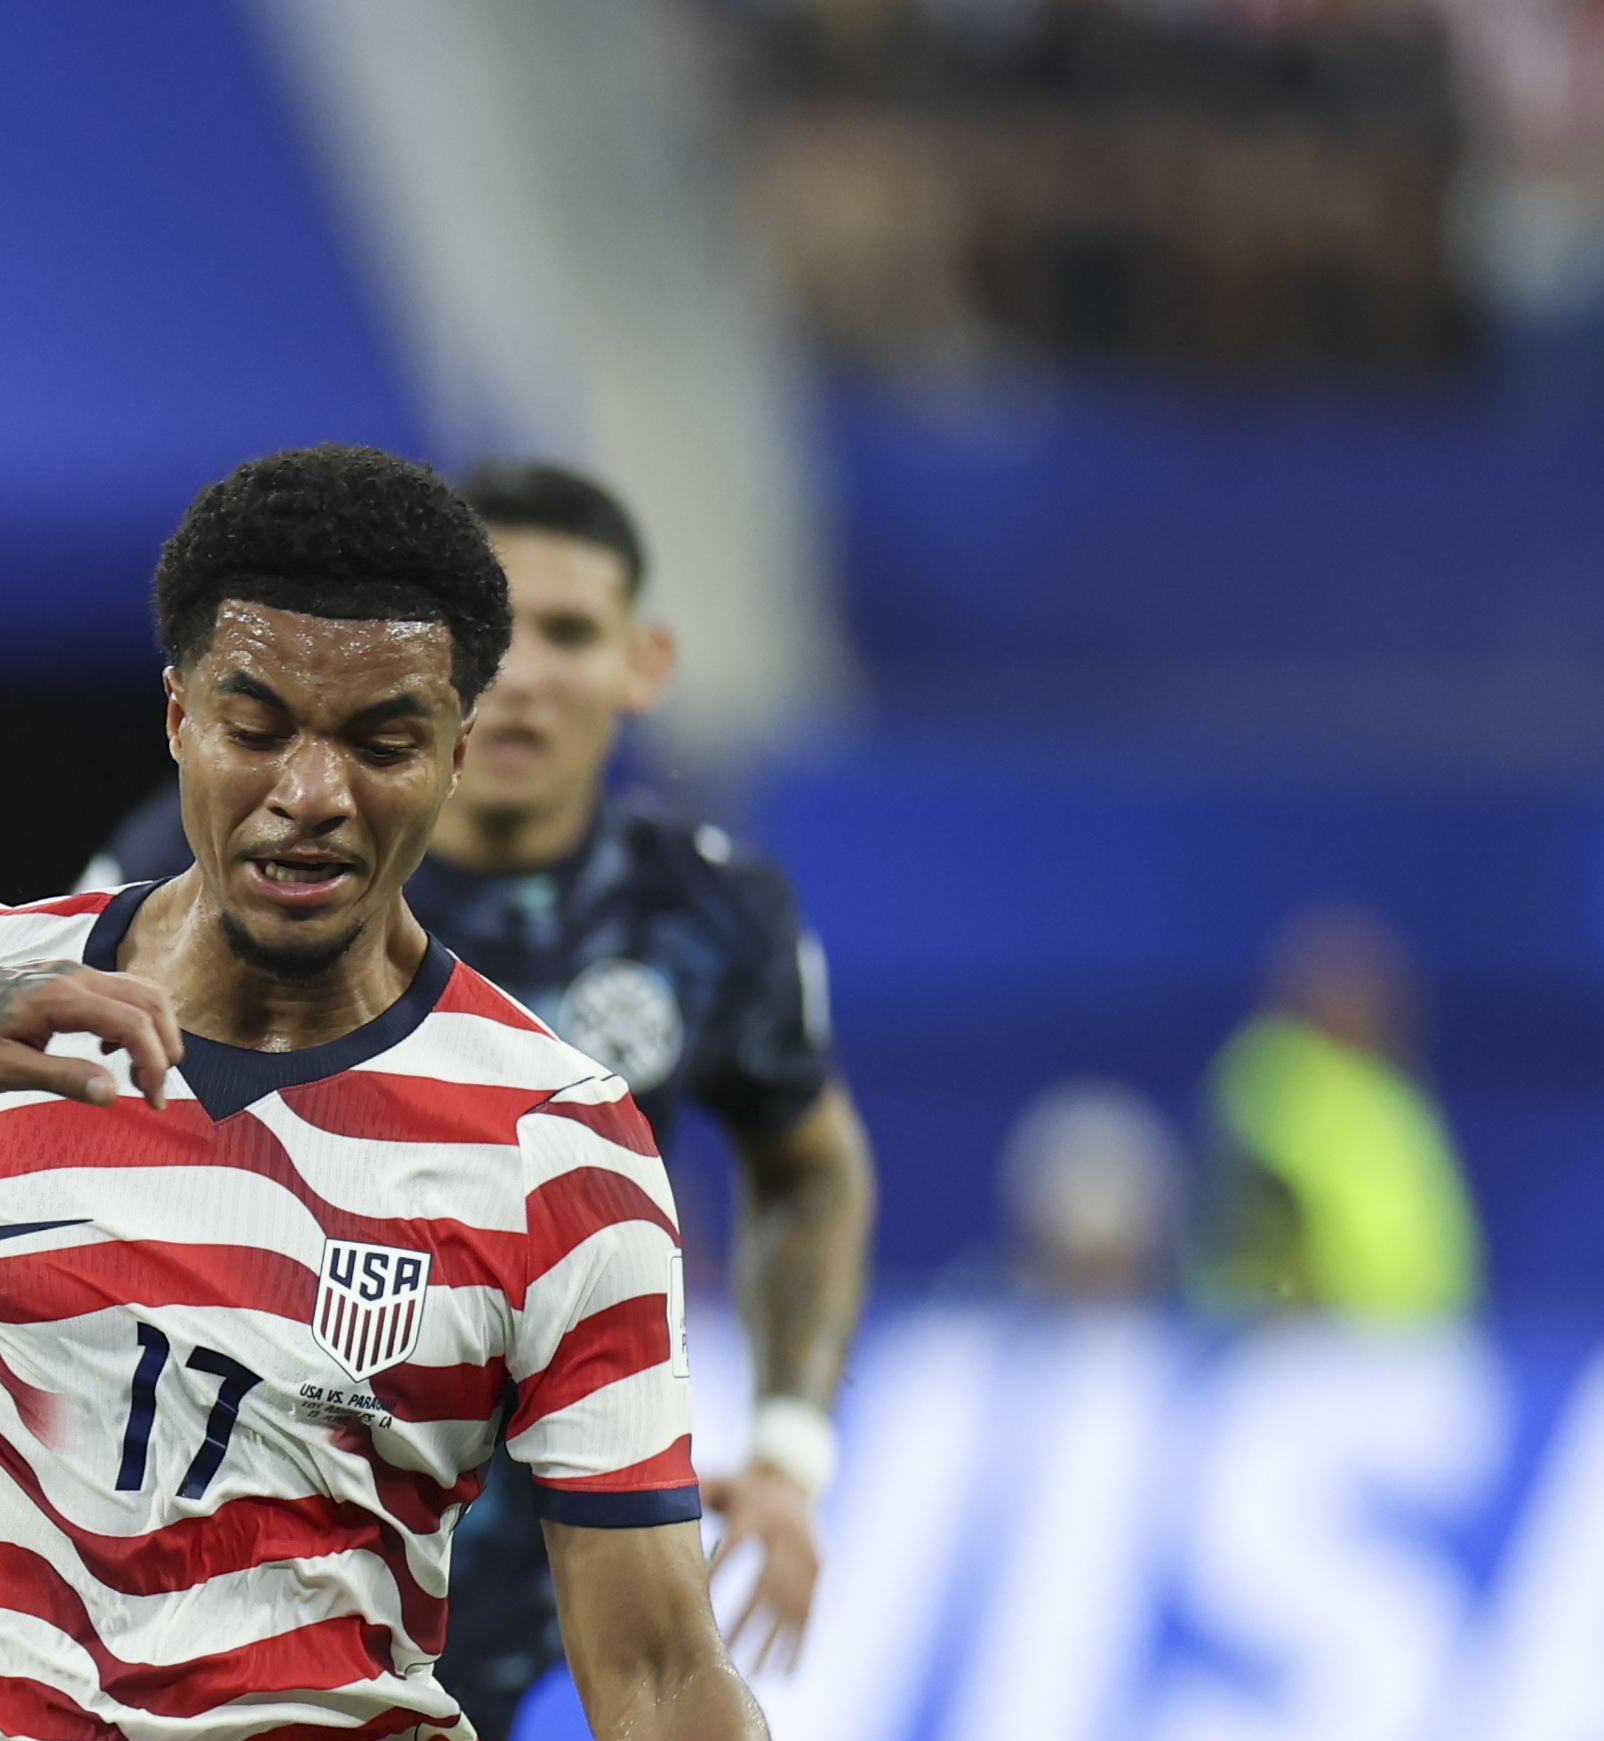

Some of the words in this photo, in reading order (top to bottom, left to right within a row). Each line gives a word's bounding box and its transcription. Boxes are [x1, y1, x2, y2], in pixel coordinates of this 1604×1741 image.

[328, 1247, 422, 1302] USA
[114, 1320, 265, 1501] 17
[299, 1383, 324, 1401] USA
